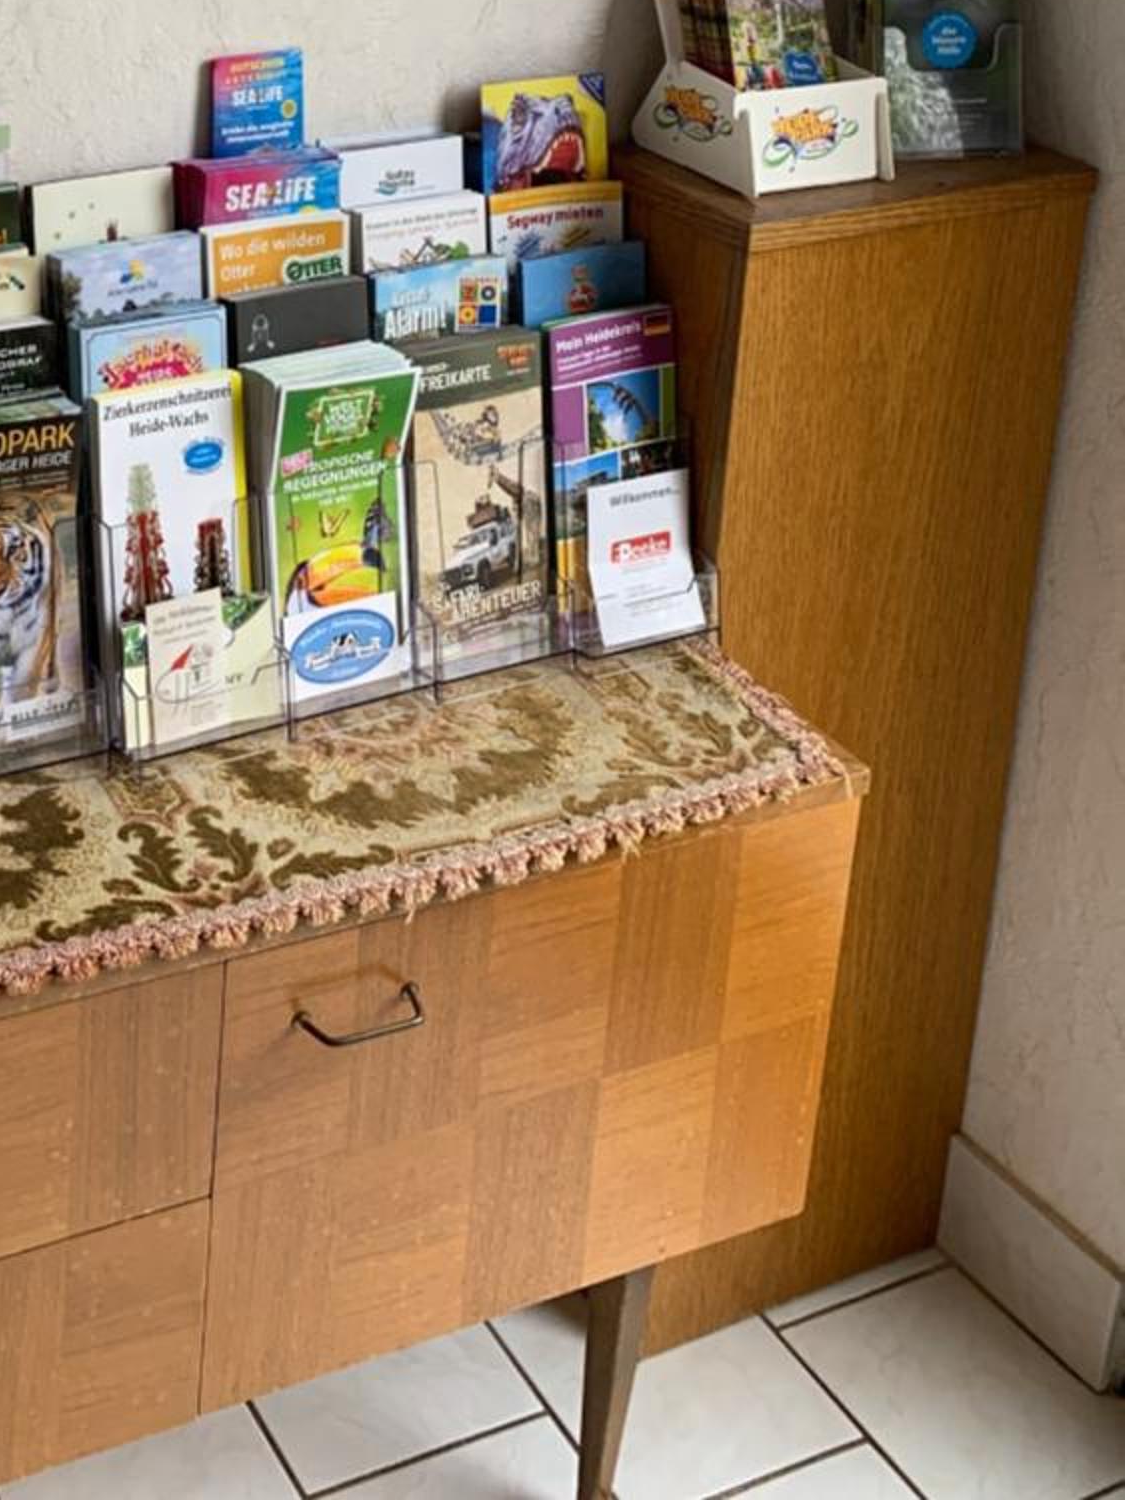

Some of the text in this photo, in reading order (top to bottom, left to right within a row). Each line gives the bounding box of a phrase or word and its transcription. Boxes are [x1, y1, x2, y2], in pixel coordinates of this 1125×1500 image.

[231, 88, 257, 107] SEA
[225, 182, 268, 213] SEA
[506, 205, 604, 231] Segway mieten
[219, 226, 326, 261] Wo die wilden
[286, 255, 343, 281] OTTER
[556, 336, 584, 353] Mein
[418, 363, 492, 393] FREIKARTE
[31, 450, 72, 468] HEIDE
